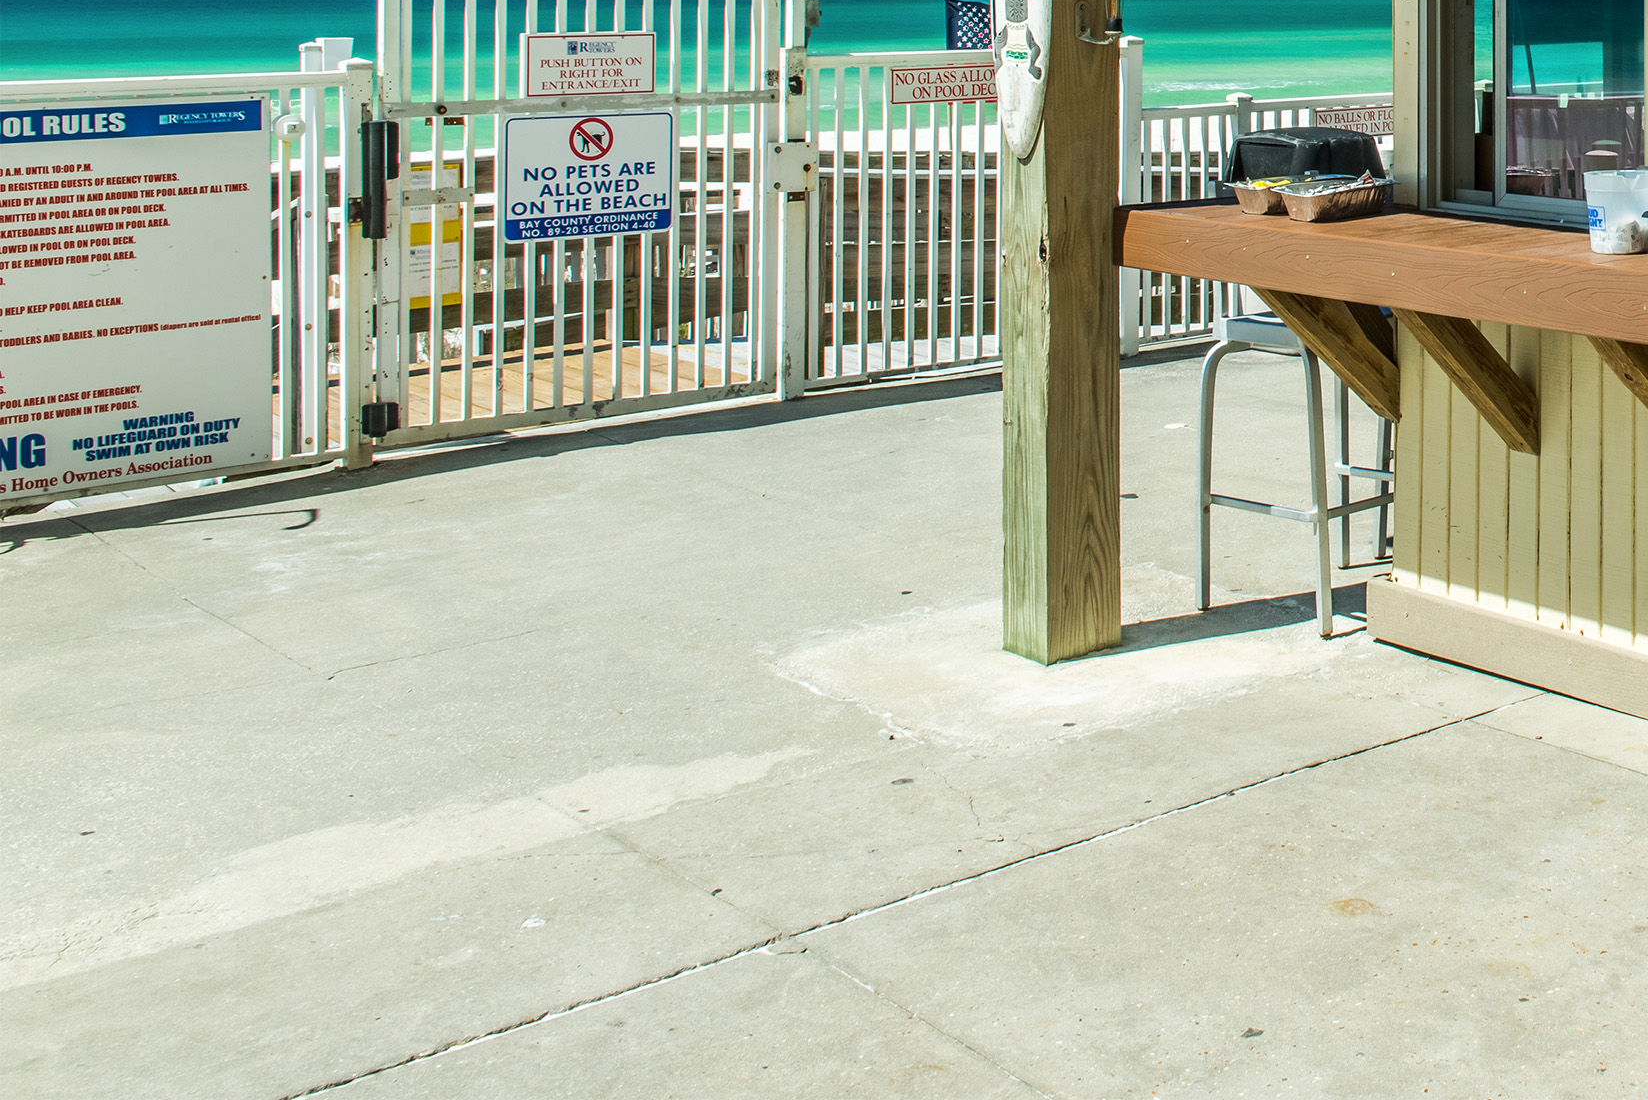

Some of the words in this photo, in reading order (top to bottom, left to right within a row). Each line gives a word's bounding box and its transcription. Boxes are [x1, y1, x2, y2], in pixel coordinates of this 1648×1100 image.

[541, 59, 570, 68] PUSH
[574, 58, 622, 67] BUTTON
[625, 57, 642, 65] ON
[560, 70, 598, 78] RIGHT
[602, 69, 623, 77] FOR
[896, 73, 915, 85] NO
[918, 71, 957, 85] GLASS
[542, 79, 641, 90] ENTRANCE/EXIT
[913, 87, 931, 99] ON
[936, 85, 968, 98] POOL
[972, 83, 996, 96] DEC
[42, 112, 127, 135] RULES
[1319, 114, 1332, 125] NO
[1334, 112, 1361, 123] BALLS
[1364, 111, 1375, 121] OR
[5, 167, 24, 177] A.M.
[25, 165, 50, 176] UNTIL
[52, 164, 75, 174] 10:00
[77, 163, 93, 173] P.M.
[523, 167, 557, 182] NO
[566, 164, 611, 179] PETS
[618, 161, 656, 176] ARE
[539, 179, 639, 198] ALLOWED
[511, 201, 545, 216] ON
[554, 198, 592, 212] THE
[601, 193, 667, 209] BEACH
[519, 219, 541, 229] BAY
[544, 216, 592, 228] COUNTY
[594, 212, 658, 225] ORDINANCE
[522, 229, 544, 238] NO.
[548, 226, 579, 236] 89-20
[582, 222, 629, 233] SECTION
[632, 221, 656, 230] 4-40
[123, 411, 195, 430] WARNING
[72, 437, 94, 450] NO
[97, 426, 177, 448] LIFEGUARD
[182, 423, 200, 436] ON
[203, 418, 240, 432] DUTY
[85, 446, 130, 462] SWIM
[134, 443, 152, 456] AT
[155, 436, 190, 452] OWN
[194, 432, 229, 447] RISK
[12, 475, 58, 492] Home
[63, 465, 122, 483] Owners
[126, 453, 213, 475] Association
